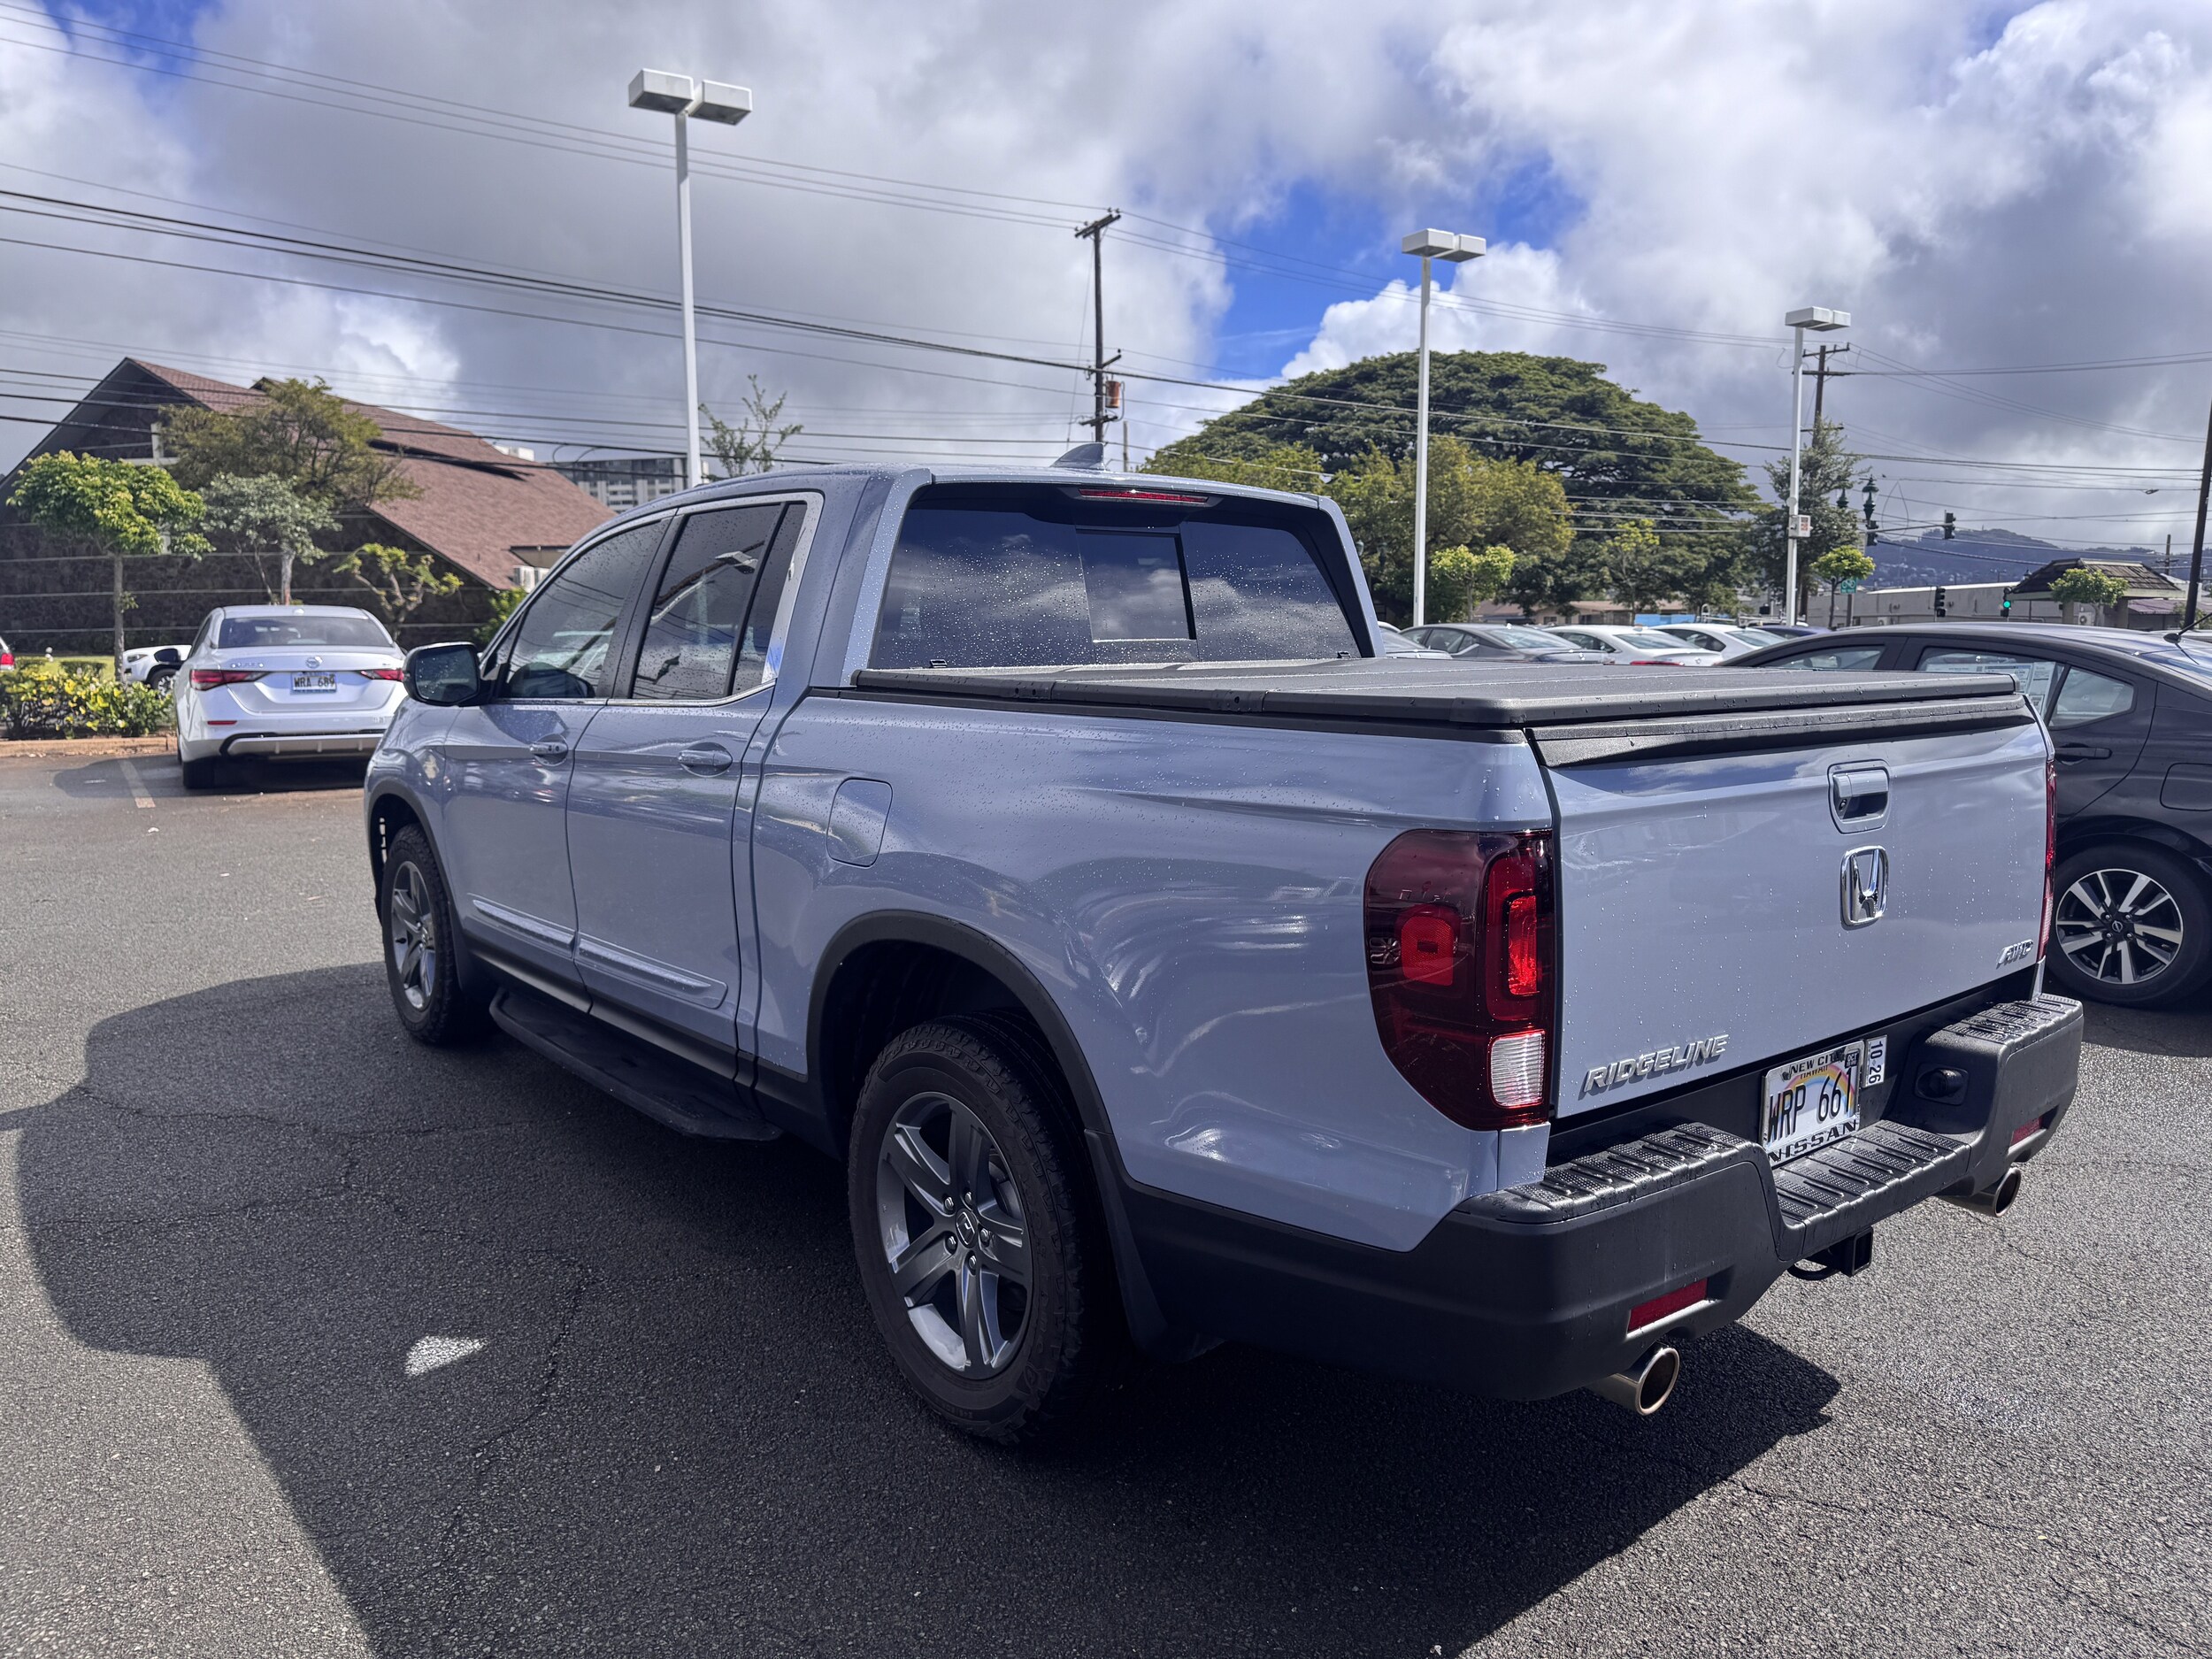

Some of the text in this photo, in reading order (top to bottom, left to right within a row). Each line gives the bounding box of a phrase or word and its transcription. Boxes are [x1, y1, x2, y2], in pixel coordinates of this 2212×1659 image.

[1584, 1034, 1730, 1093] RIDGELINE
[1790, 1050, 1844, 1074] NEW CIT
[1847, 1052, 1857, 1062] OCT
[1768, 1067, 1852, 1143] WRP 661
[1768, 1119, 1856, 1163] NISSAN
